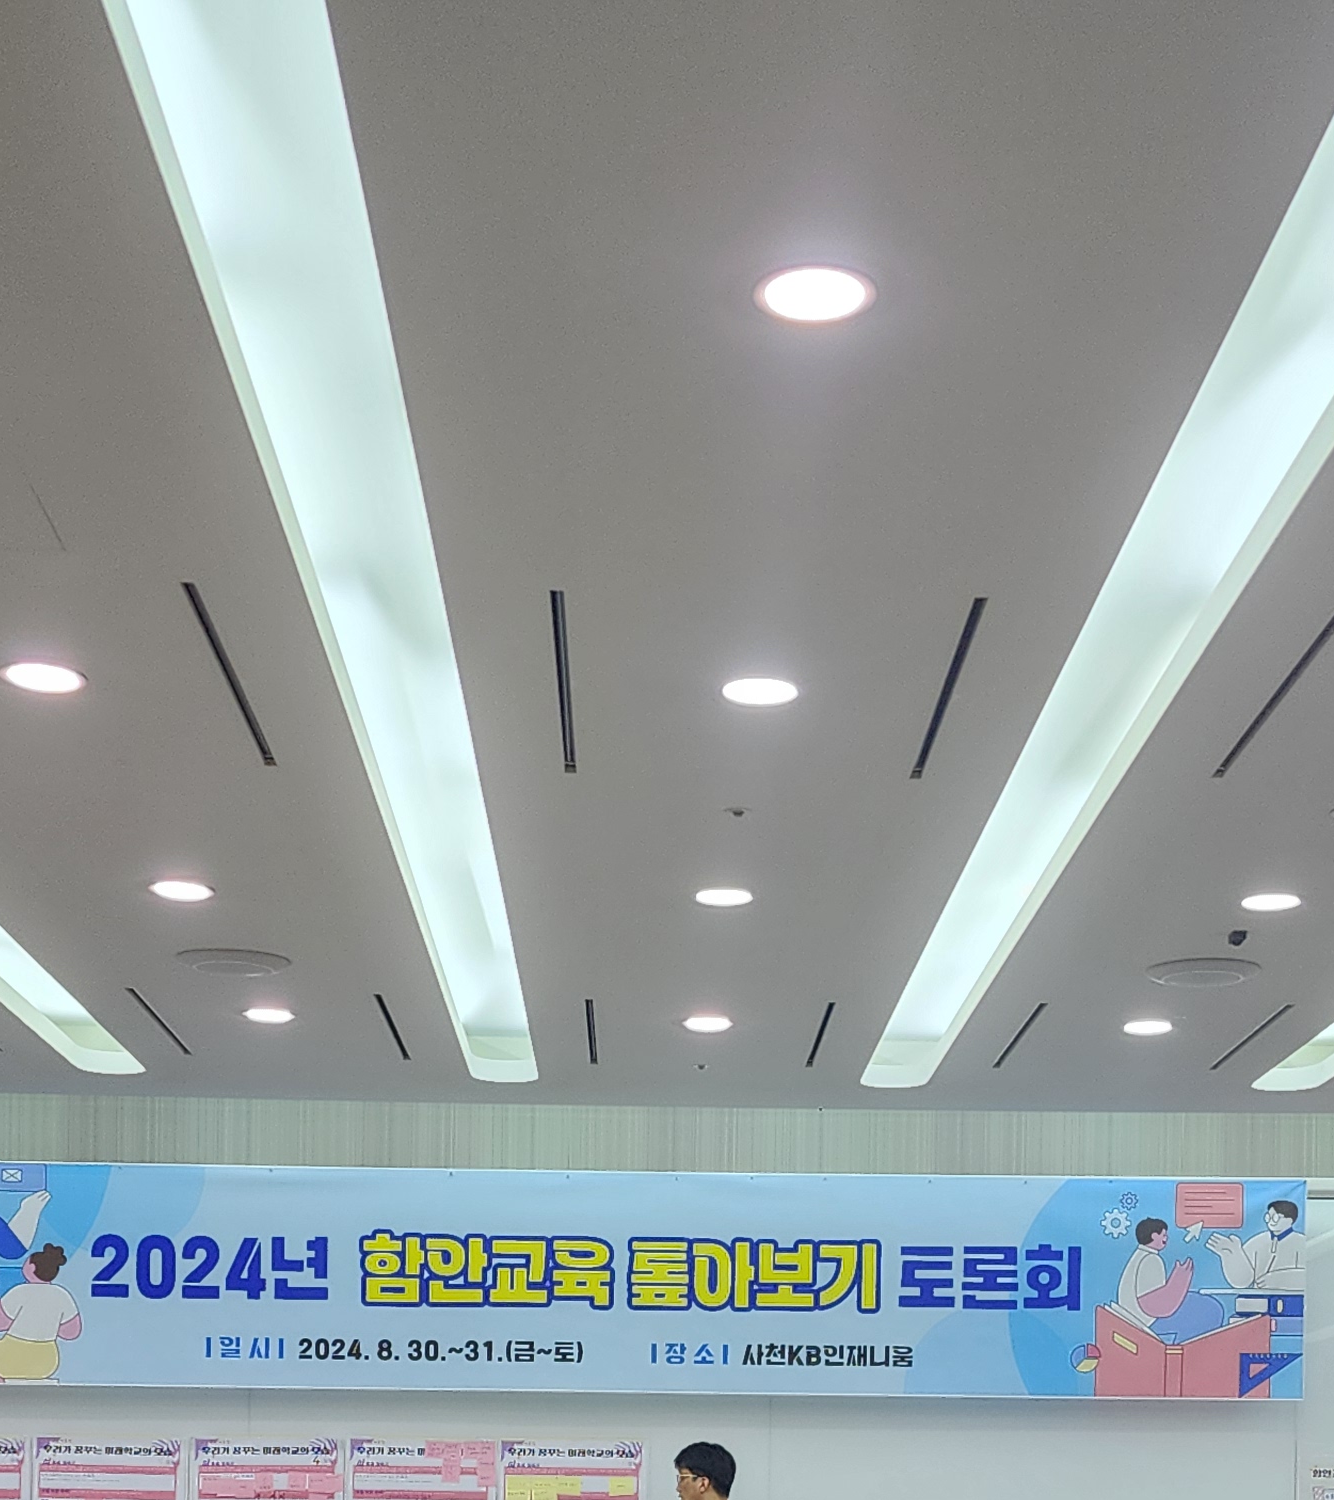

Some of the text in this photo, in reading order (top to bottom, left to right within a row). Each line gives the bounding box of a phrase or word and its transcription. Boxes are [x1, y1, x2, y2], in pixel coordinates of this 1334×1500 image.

[90, 1228, 1082, 1315] 2024년 함안교육 톺아보기 토론회
[298, 1338, 370, 1361] 2024.
[376, 1338, 400, 1361] 8.
[742, 1342, 914, 1368] 사천KB인재니움
